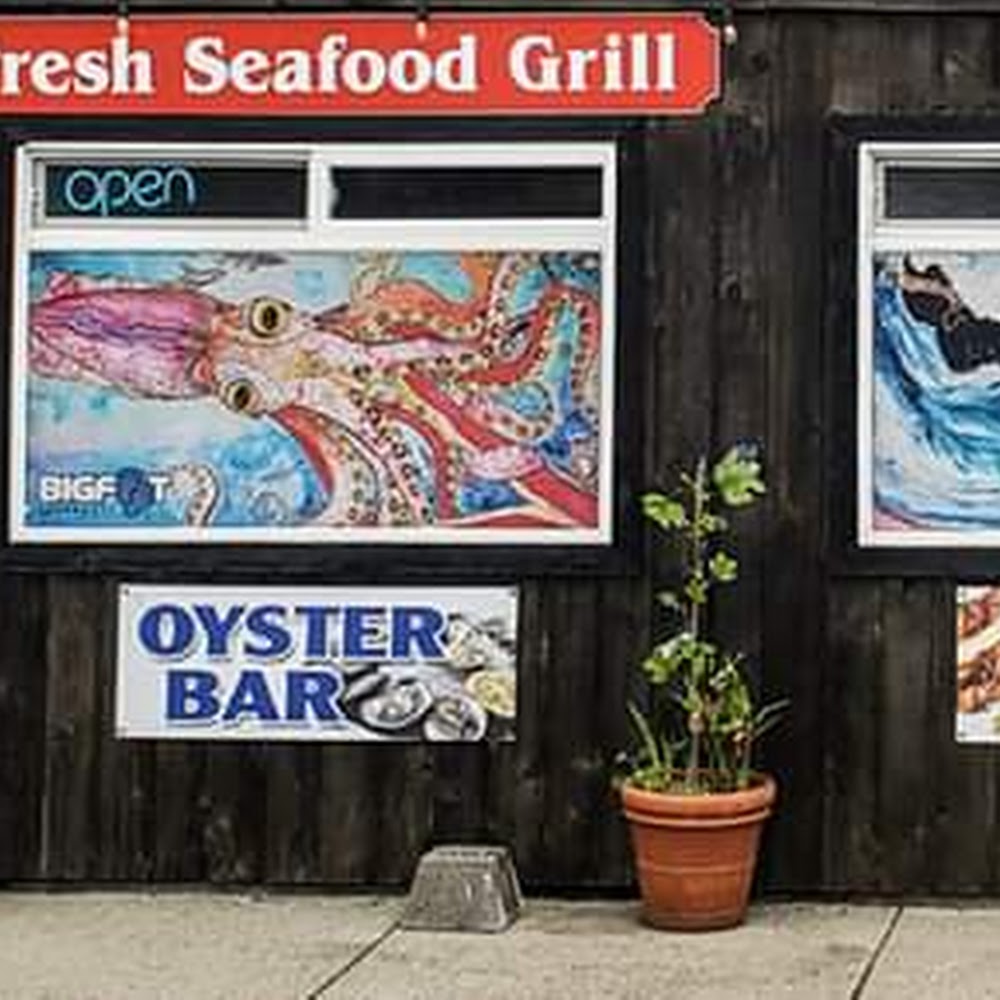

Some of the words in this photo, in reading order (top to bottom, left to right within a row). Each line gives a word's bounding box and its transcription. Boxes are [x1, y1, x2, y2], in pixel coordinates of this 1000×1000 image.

[0, 35, 155, 94] resh
[183, 34, 479, 94] Seafood
[509, 33, 677, 93] Grill
[64, 167, 197, 217] open
[40, 474, 170, 503] BIGFT
[137, 604, 448, 658] OYSTER
[165, 669, 343, 722] BAR
